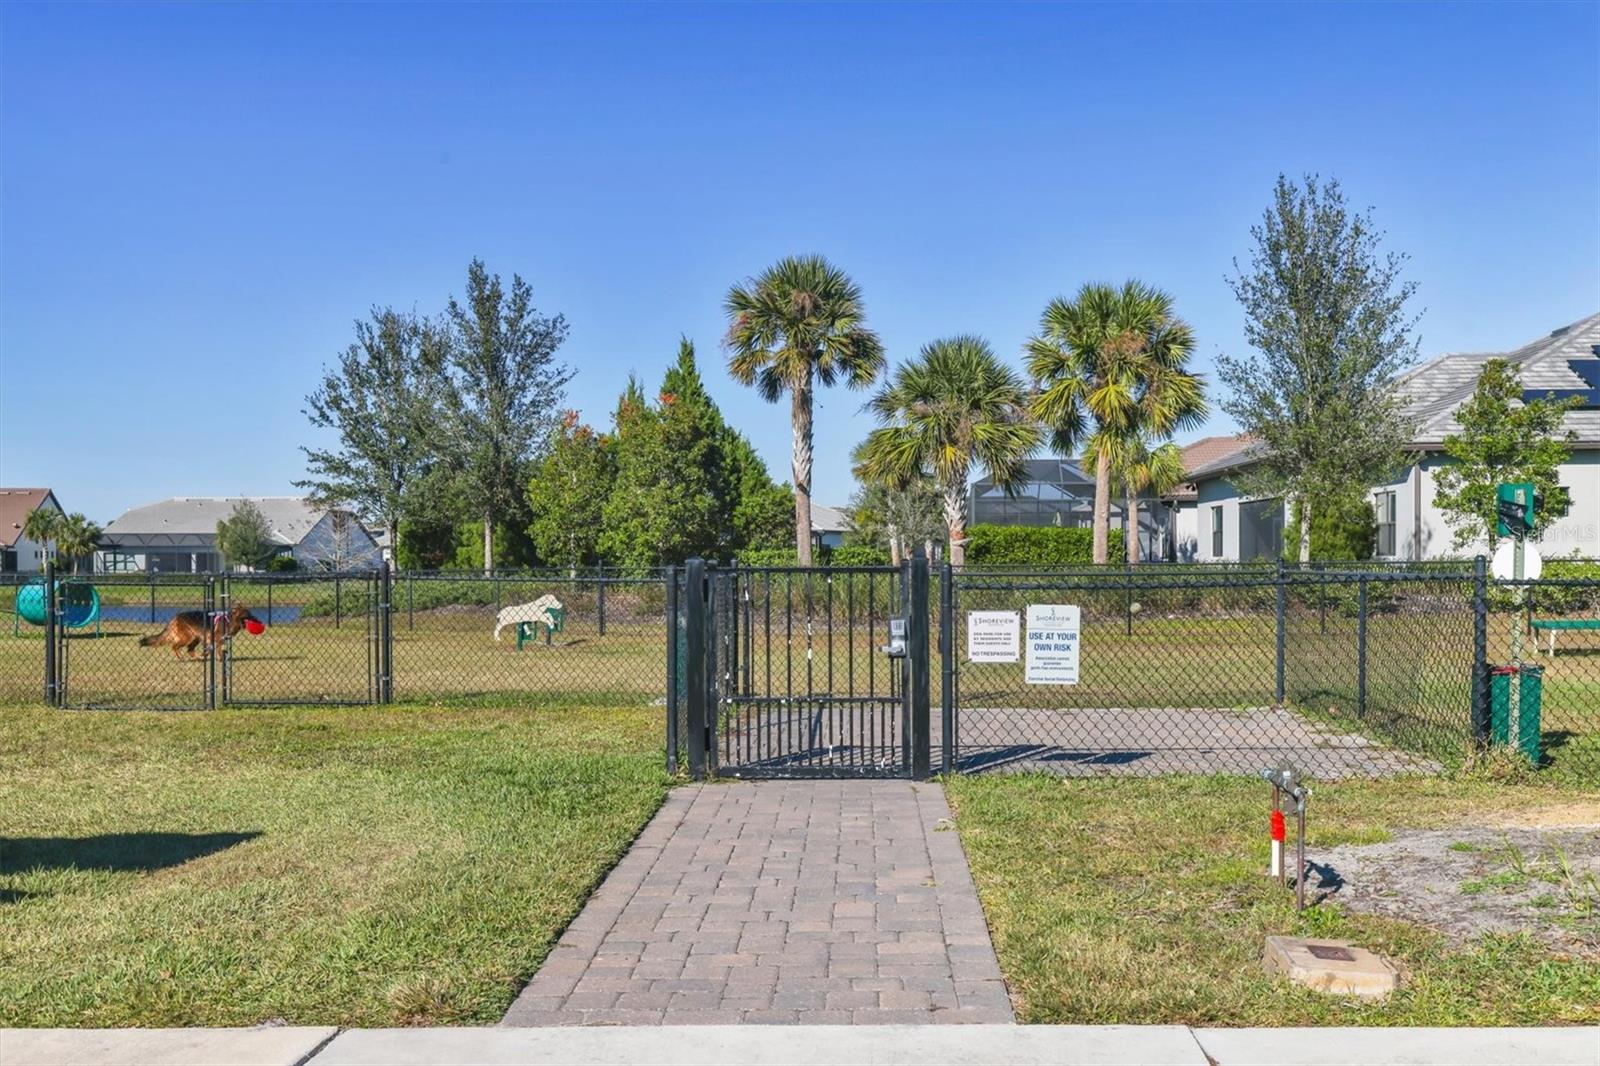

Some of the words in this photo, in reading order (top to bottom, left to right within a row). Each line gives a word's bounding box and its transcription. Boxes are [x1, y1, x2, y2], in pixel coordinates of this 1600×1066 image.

[1029, 632, 1044, 640] USE
[1045, 632, 1055, 640] AT
[1056, 632, 1077, 641] YOUR
[1034, 643, 1052, 651] OWN
[1053, 643, 1071, 651] RISK
